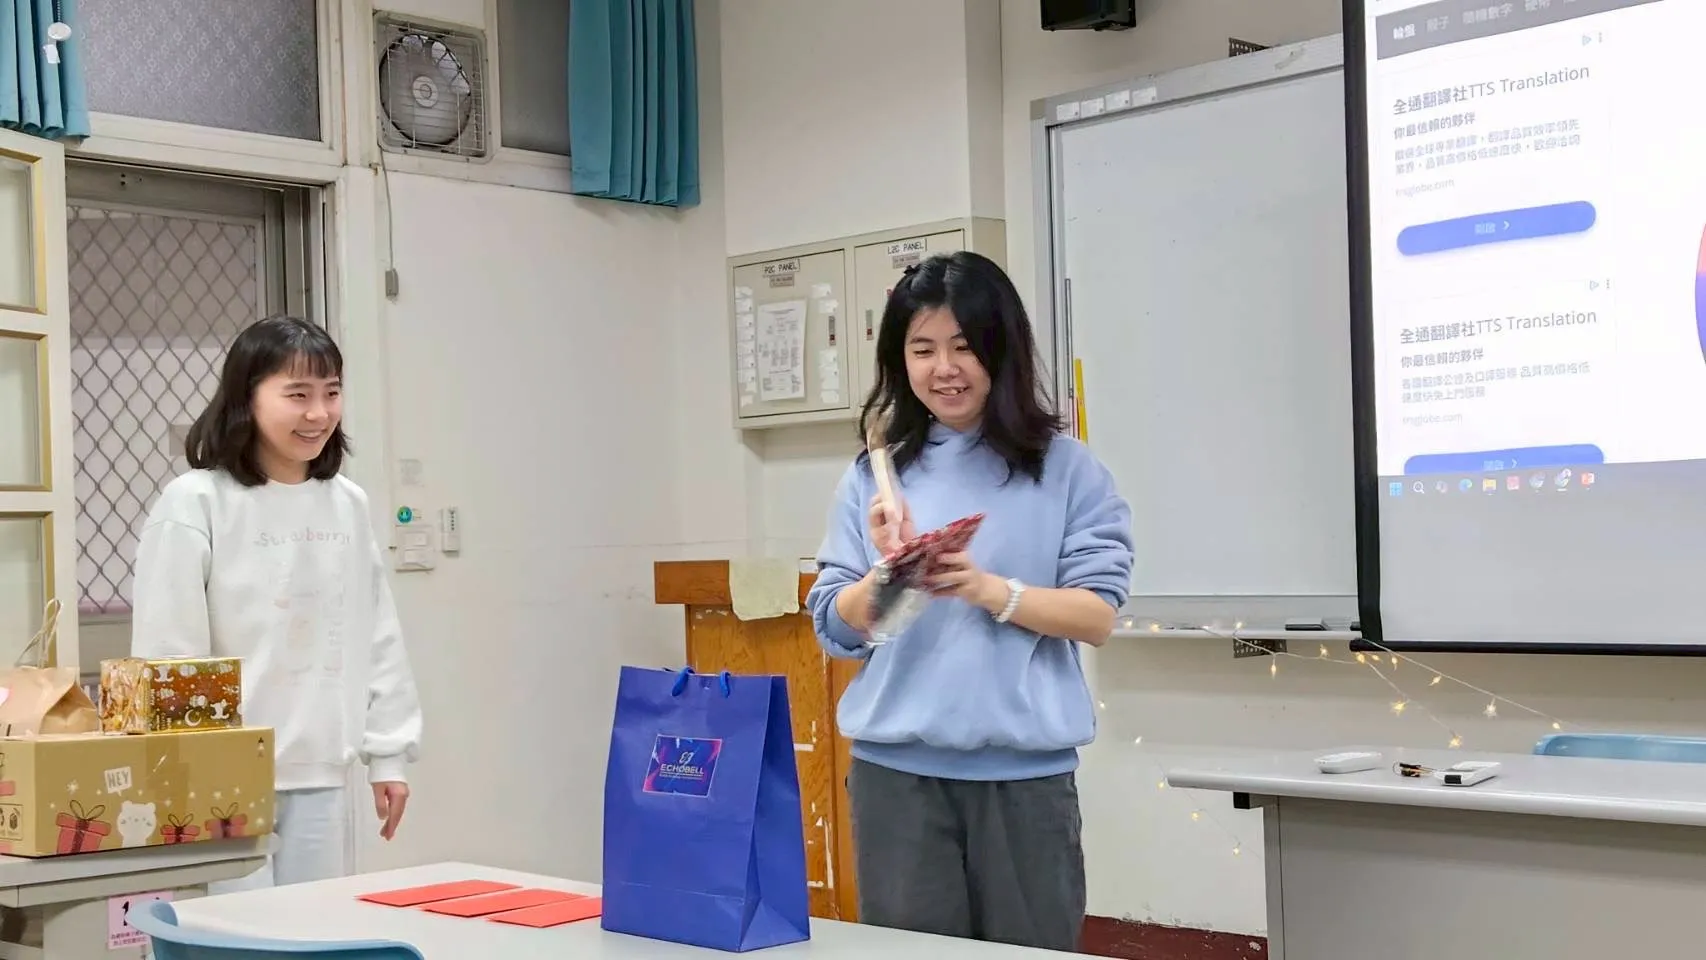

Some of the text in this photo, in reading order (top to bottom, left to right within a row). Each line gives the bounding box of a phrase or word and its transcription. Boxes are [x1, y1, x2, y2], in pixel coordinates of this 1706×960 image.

[1393, 23, 1416, 39] 輪盤
[1393, 66, 1590, 115] 全通翻譯社TTS Translation
[1394, 112, 1476, 140] 你最信賴的夥伴
[903, 242, 924, 252] PANEL
[778, 261, 798, 271] PANEL
[1400, 309, 1597, 345] 全通翻譯社TTS Translation
[1400, 347, 1484, 369] 你最信賴的夥伴
[660, 763, 704, 774] ECHOBELL
[106, 771, 129, 787] HEY
